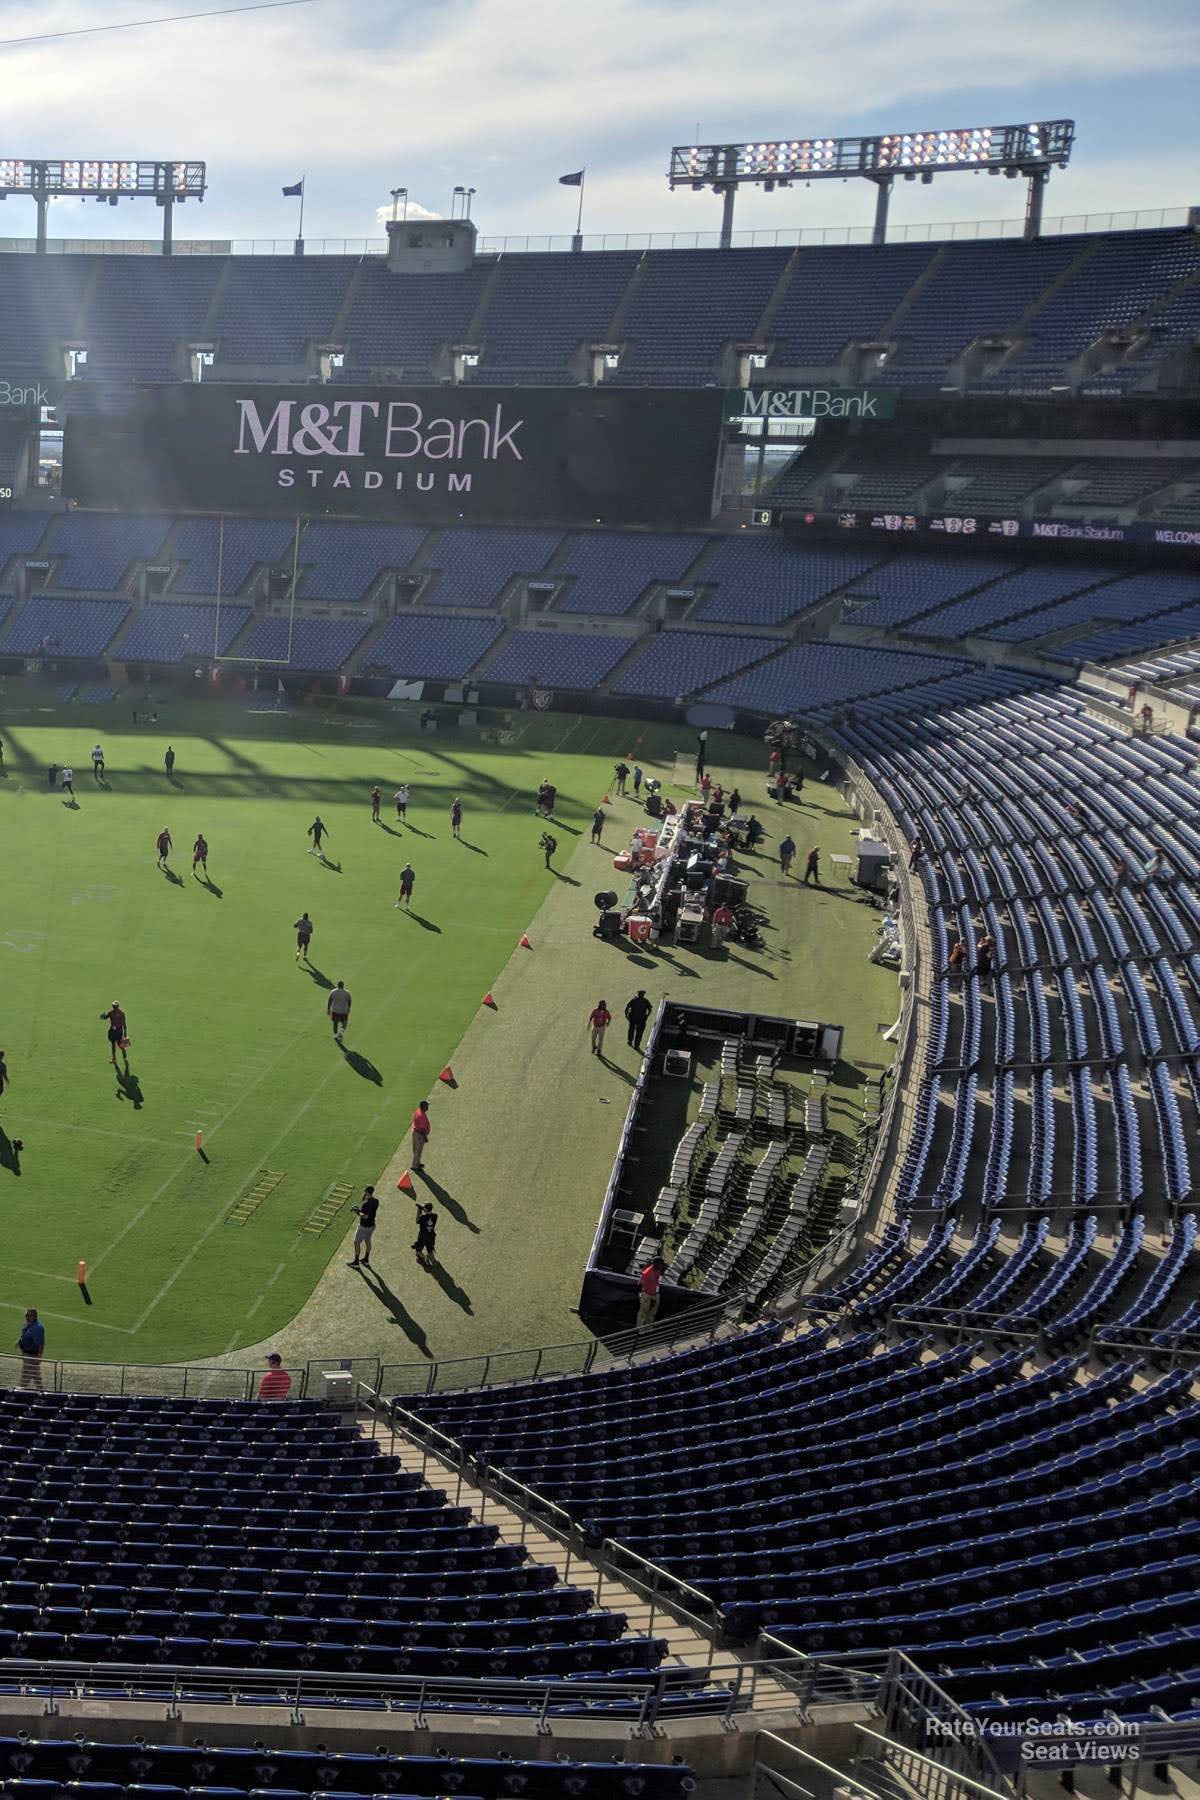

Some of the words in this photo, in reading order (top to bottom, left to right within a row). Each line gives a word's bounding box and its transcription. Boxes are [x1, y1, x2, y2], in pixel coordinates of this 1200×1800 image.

[741, 390, 810, 416] M&T
[811, 390, 877, 417] Bank
[233, 400, 379, 457] M&T
[385, 402, 523, 460] Bank
[278, 468, 472, 492] STADIUM
[1032, 523, 1060, 537] M&T
[1060, 525, 1083, 538] Bank
[1084, 526, 1124, 540] Stadium
